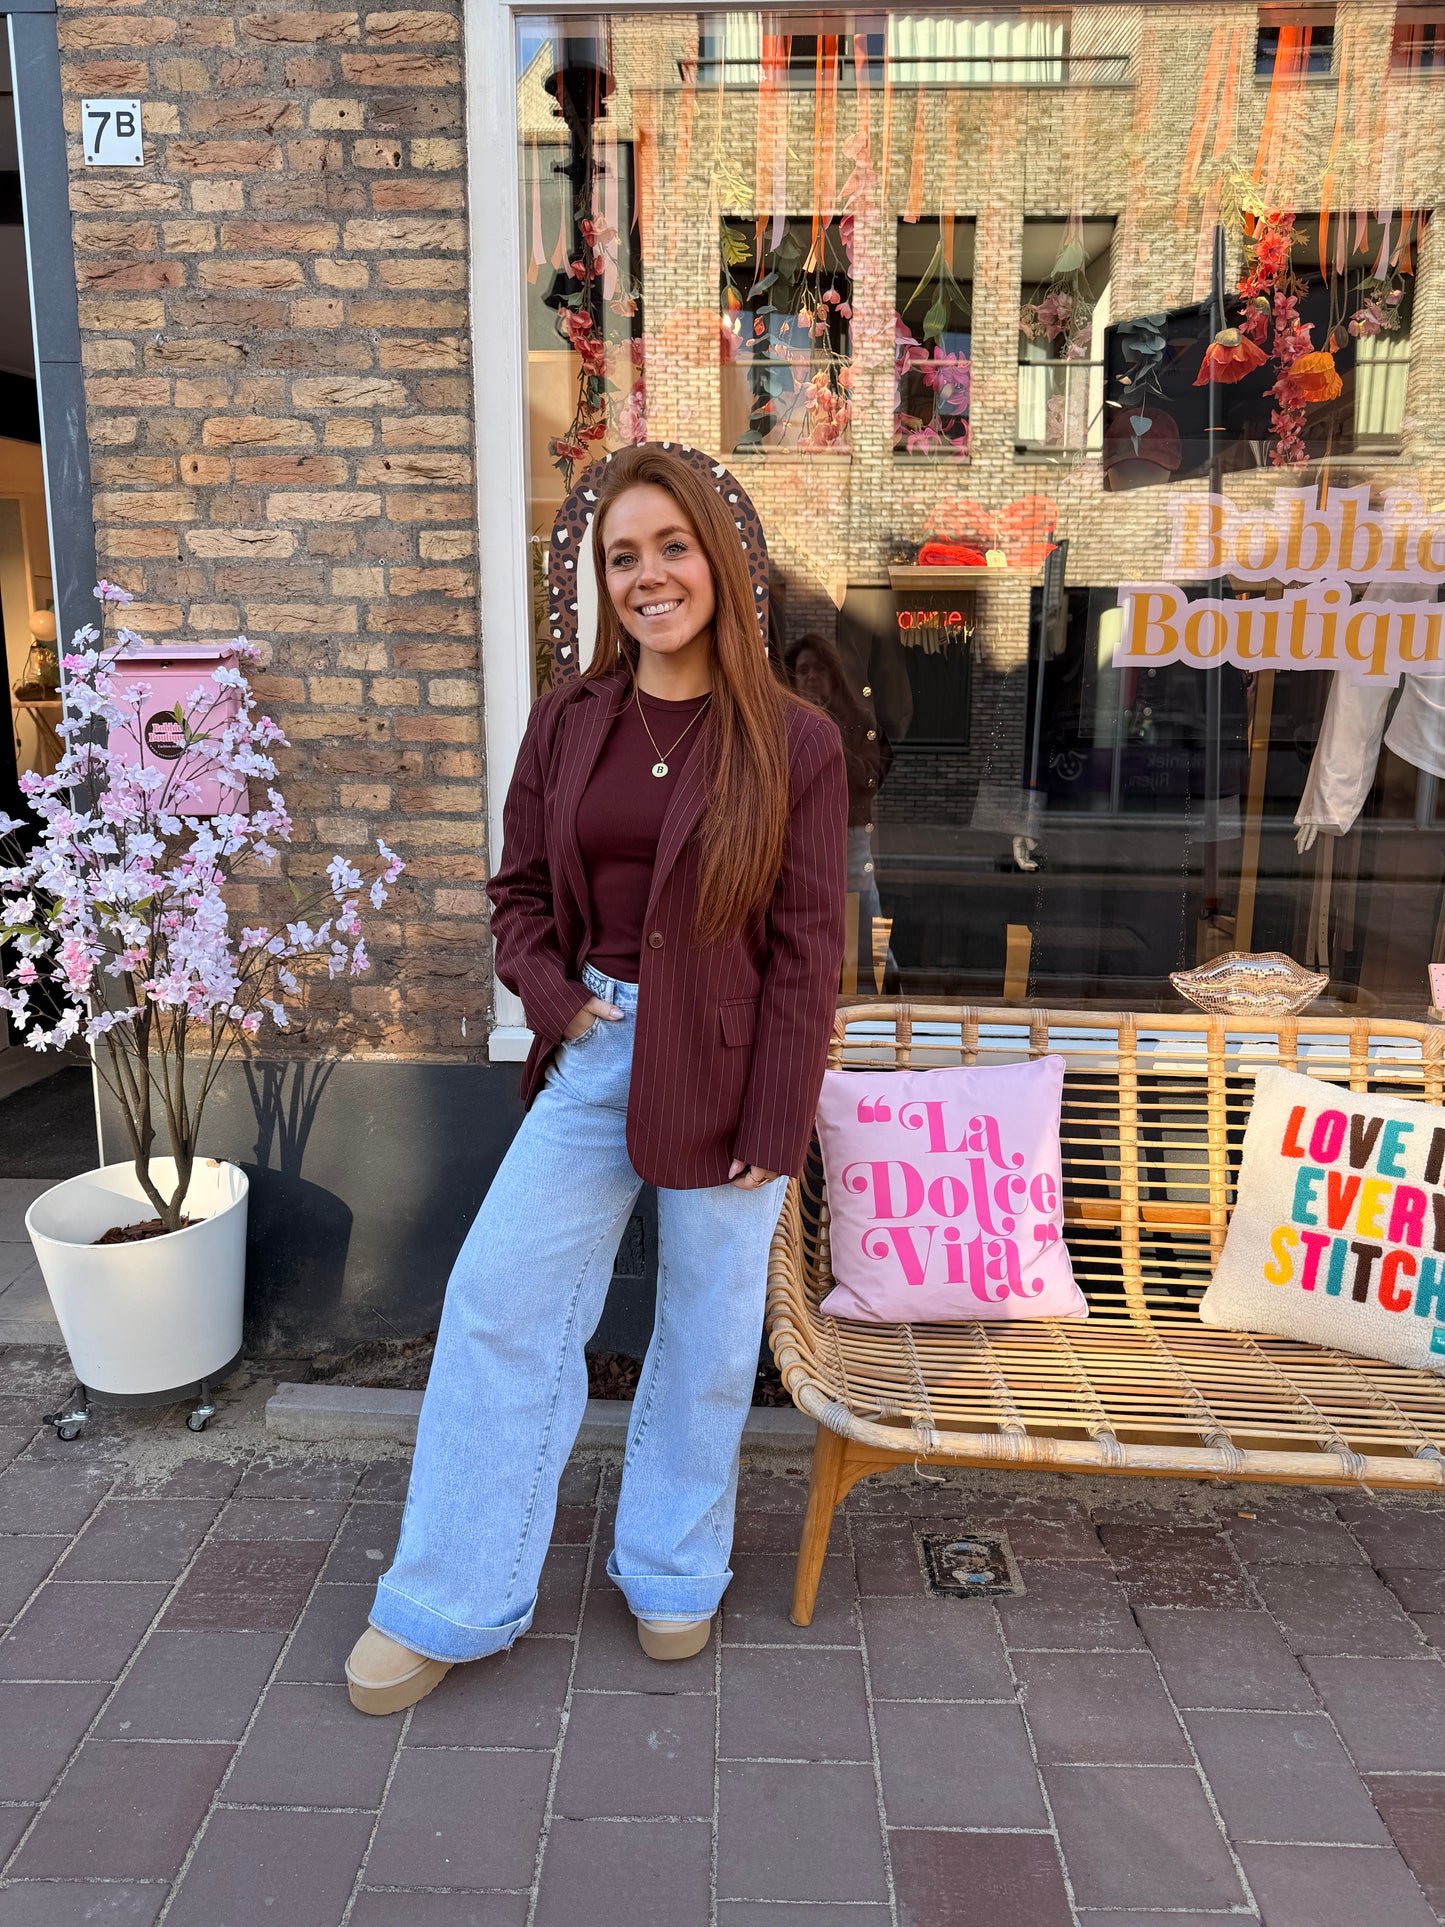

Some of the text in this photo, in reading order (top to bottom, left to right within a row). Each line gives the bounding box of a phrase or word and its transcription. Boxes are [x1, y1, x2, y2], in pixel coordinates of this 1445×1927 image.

[87, 111, 136, 154] 7B
[1176, 499, 1445, 573] Bobbie
[1123, 589, 1445, 677] Boutiqu
[149, 733, 185, 743] Boutiqu
[1280, 1105, 1445, 1188] LOVE I
[841, 1157, 1057, 1237] Dolce
[1263, 1225, 1445, 1323] STITCH
